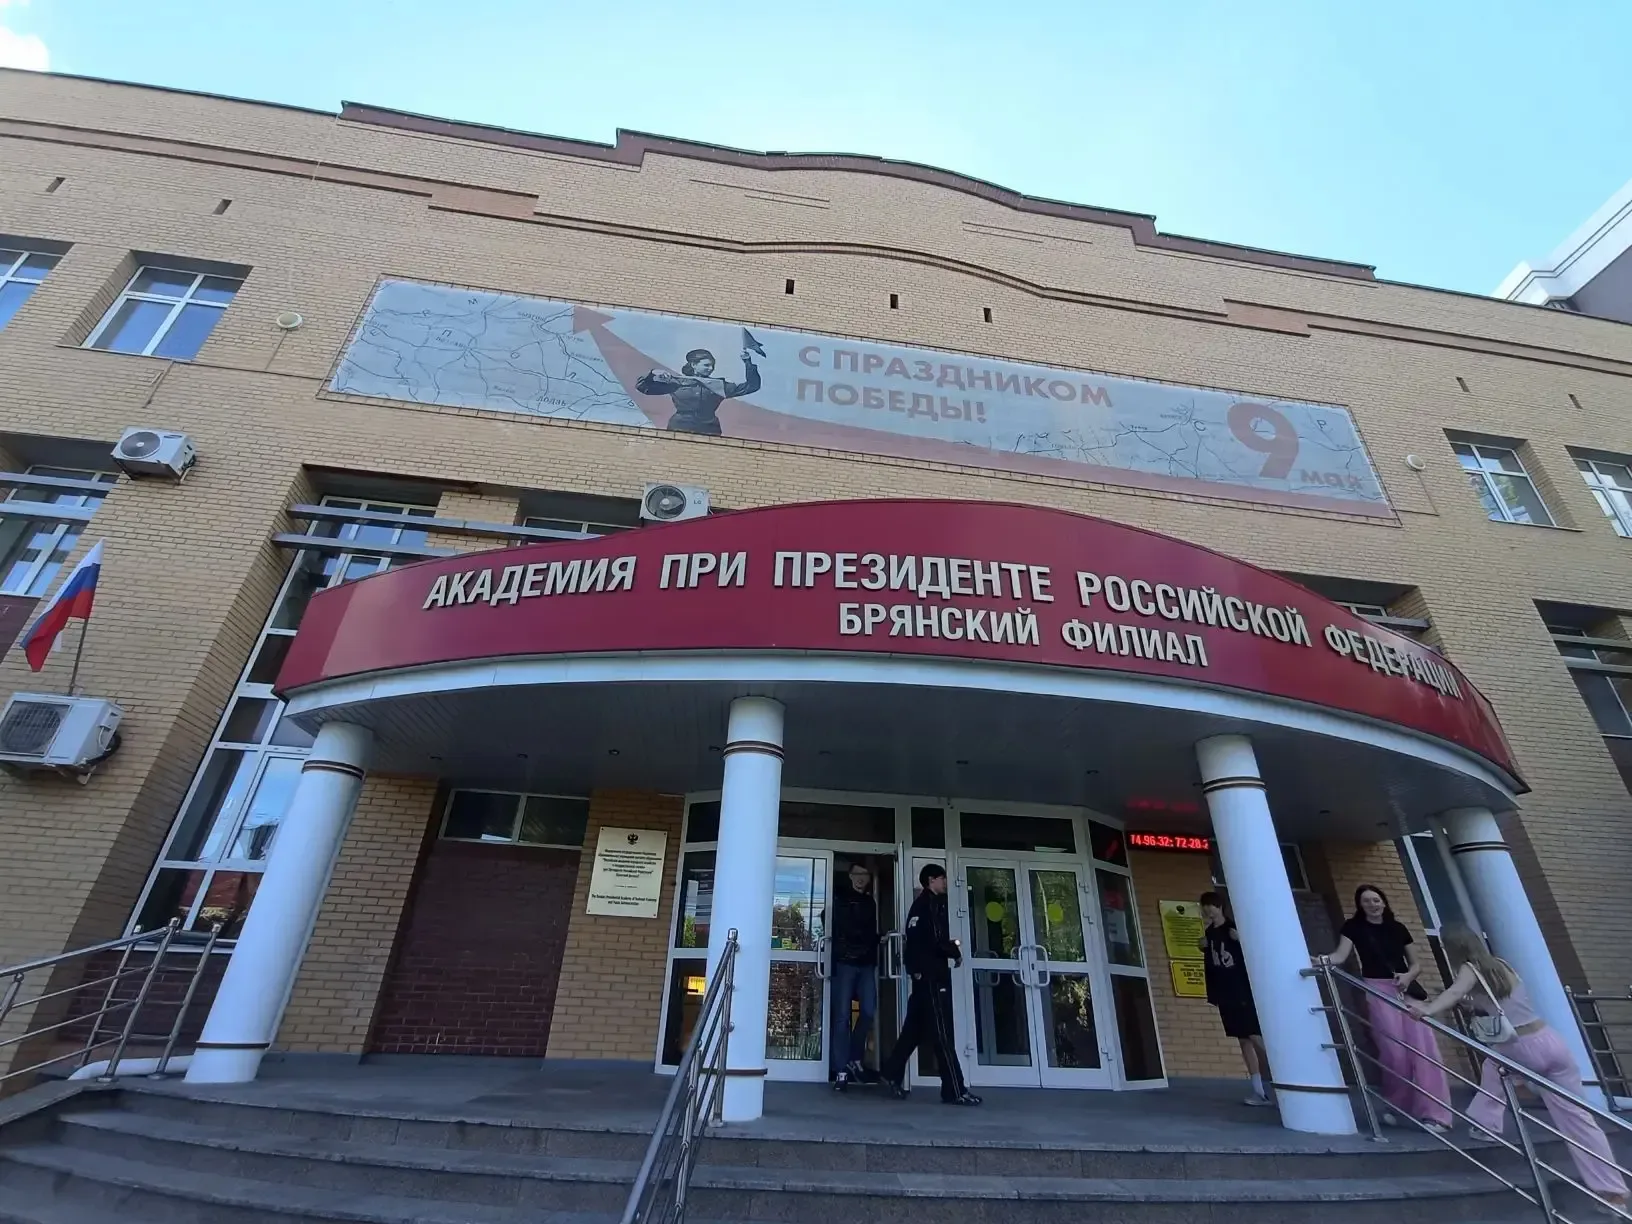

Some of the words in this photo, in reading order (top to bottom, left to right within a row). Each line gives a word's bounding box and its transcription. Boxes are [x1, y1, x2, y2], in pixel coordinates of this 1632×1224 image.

[797, 378, 987, 424] ПОБЕДЫ!
[798, 345, 821, 367] С
[833, 349, 1113, 408] ПРАЗДНИКОМ
[1227, 402, 1299, 479] 9
[1301, 468, 1363, 490] мая
[422, 556, 637, 610] АКАДЕМИЯ
[659, 551, 747, 589] ПРИ
[774, 551, 1055, 602] ПРЕЗИДЕНТЕ
[1076, 571, 1313, 648] РОССИЙСКОЙ
[1324, 623, 1463, 700] ФЕДЕРАЦИИ
[839, 602, 1040, 646] БРЯНСКИЙ
[1061, 618, 1209, 667] ФИЛИАЛ
